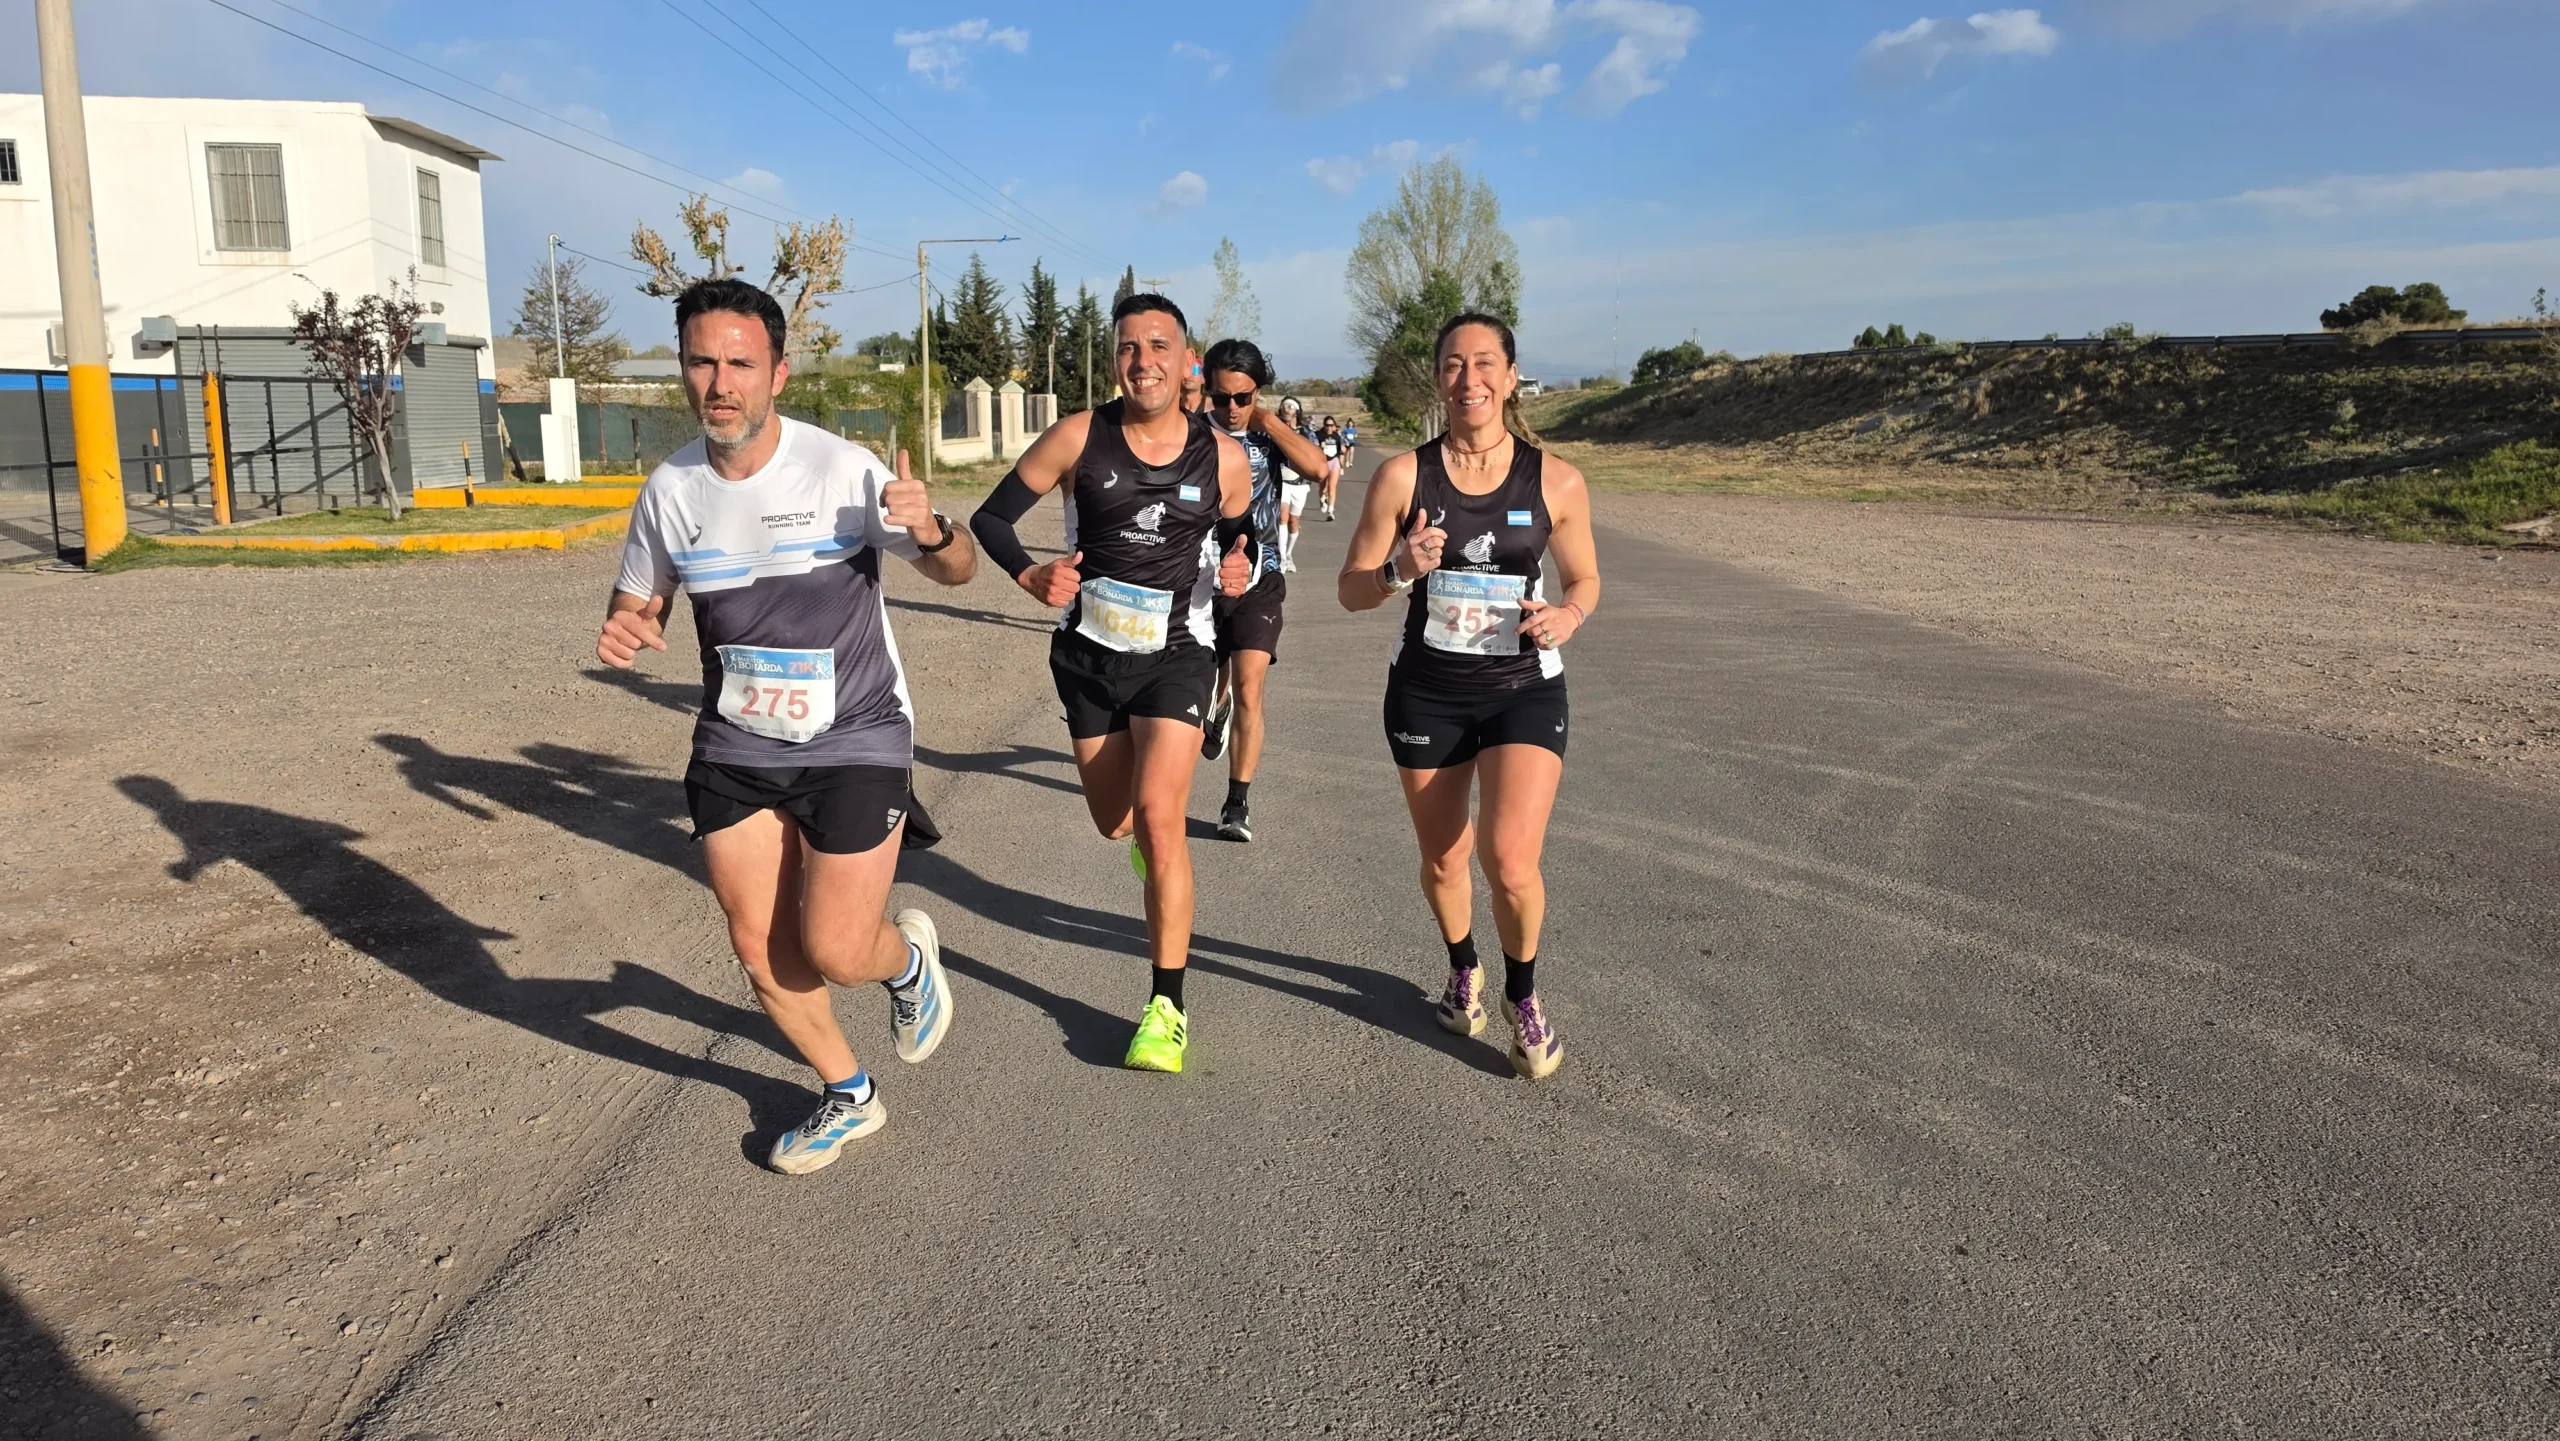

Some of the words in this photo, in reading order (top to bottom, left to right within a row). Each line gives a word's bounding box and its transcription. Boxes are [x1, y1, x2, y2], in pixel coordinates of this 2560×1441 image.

[761, 511, 816, 523] PROACTIVE
[1120, 530, 1167, 544] PROACTIVE
[1097, 588, 1134, 603] BONARDA
[1136, 596, 1156, 608] 10K
[1445, 585, 1484, 595] BONARDA
[1092, 604, 1156, 641] 1044
[1444, 605, 1501, 635] 252
[738, 661, 784, 673] BONARDA
[787, 661, 815, 675] 21K
[740, 685, 809, 720] 275
